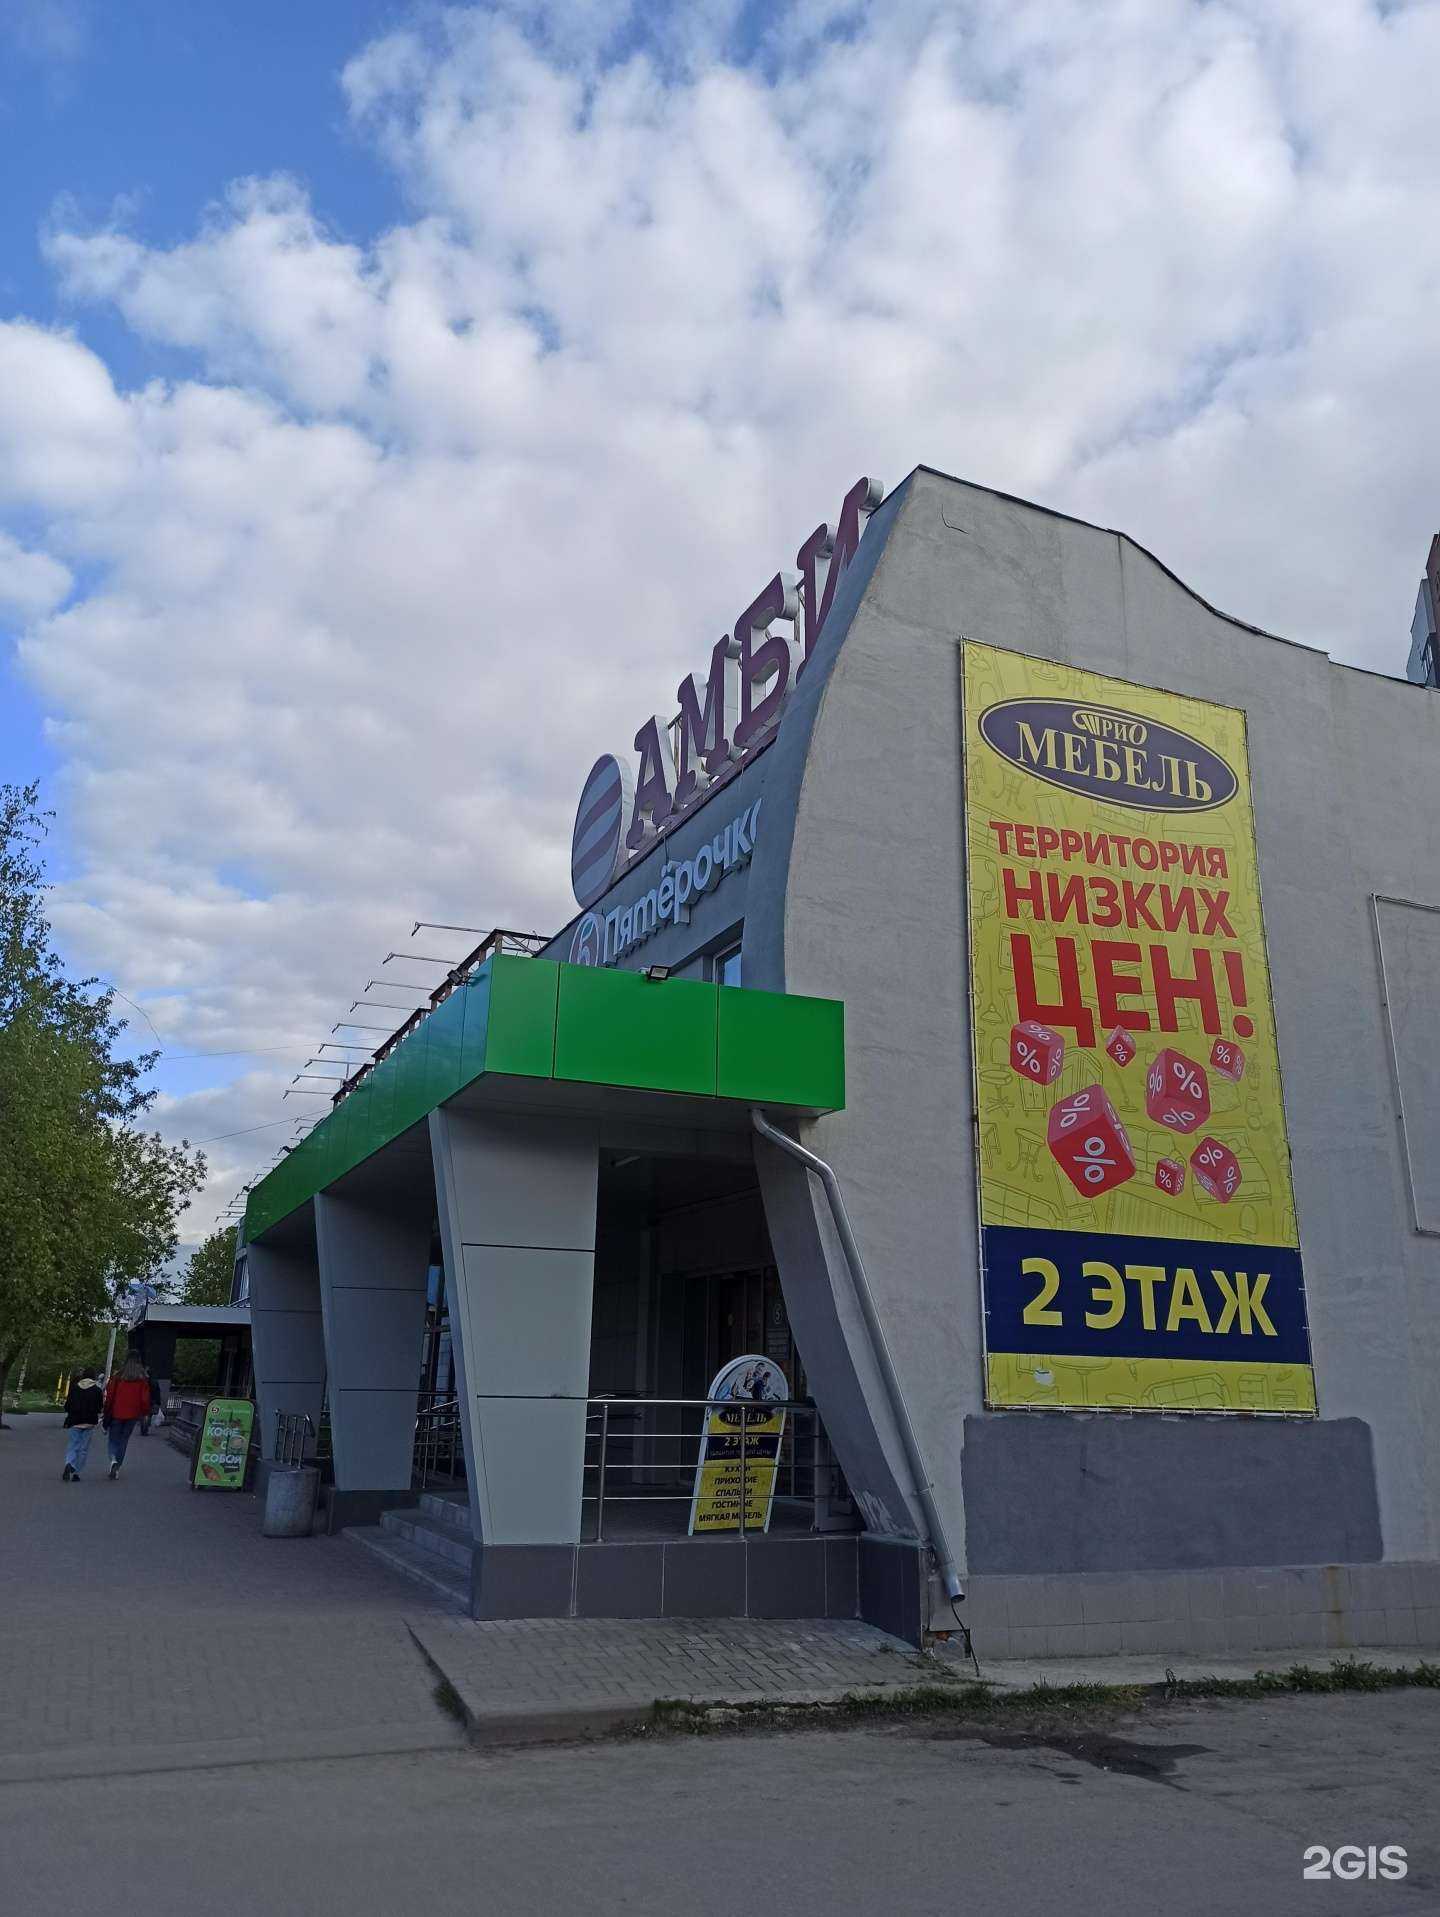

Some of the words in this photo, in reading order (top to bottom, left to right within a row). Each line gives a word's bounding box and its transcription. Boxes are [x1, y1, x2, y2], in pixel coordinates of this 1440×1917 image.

[1014, 719, 1213, 805] МЕБЕЛЬ
[989, 820, 1229, 879] ТЕРРИТОРИЯ
[1002, 867, 1238, 938] НИЗКИХ
[1010, 932, 1255, 1048] ЦЕН!
[1021, 1256, 1063, 1327] 2
[1081, 1261, 1279, 1337] ЭТАЖ
[731, 1511, 762, 1520] МБЕЛЬ
